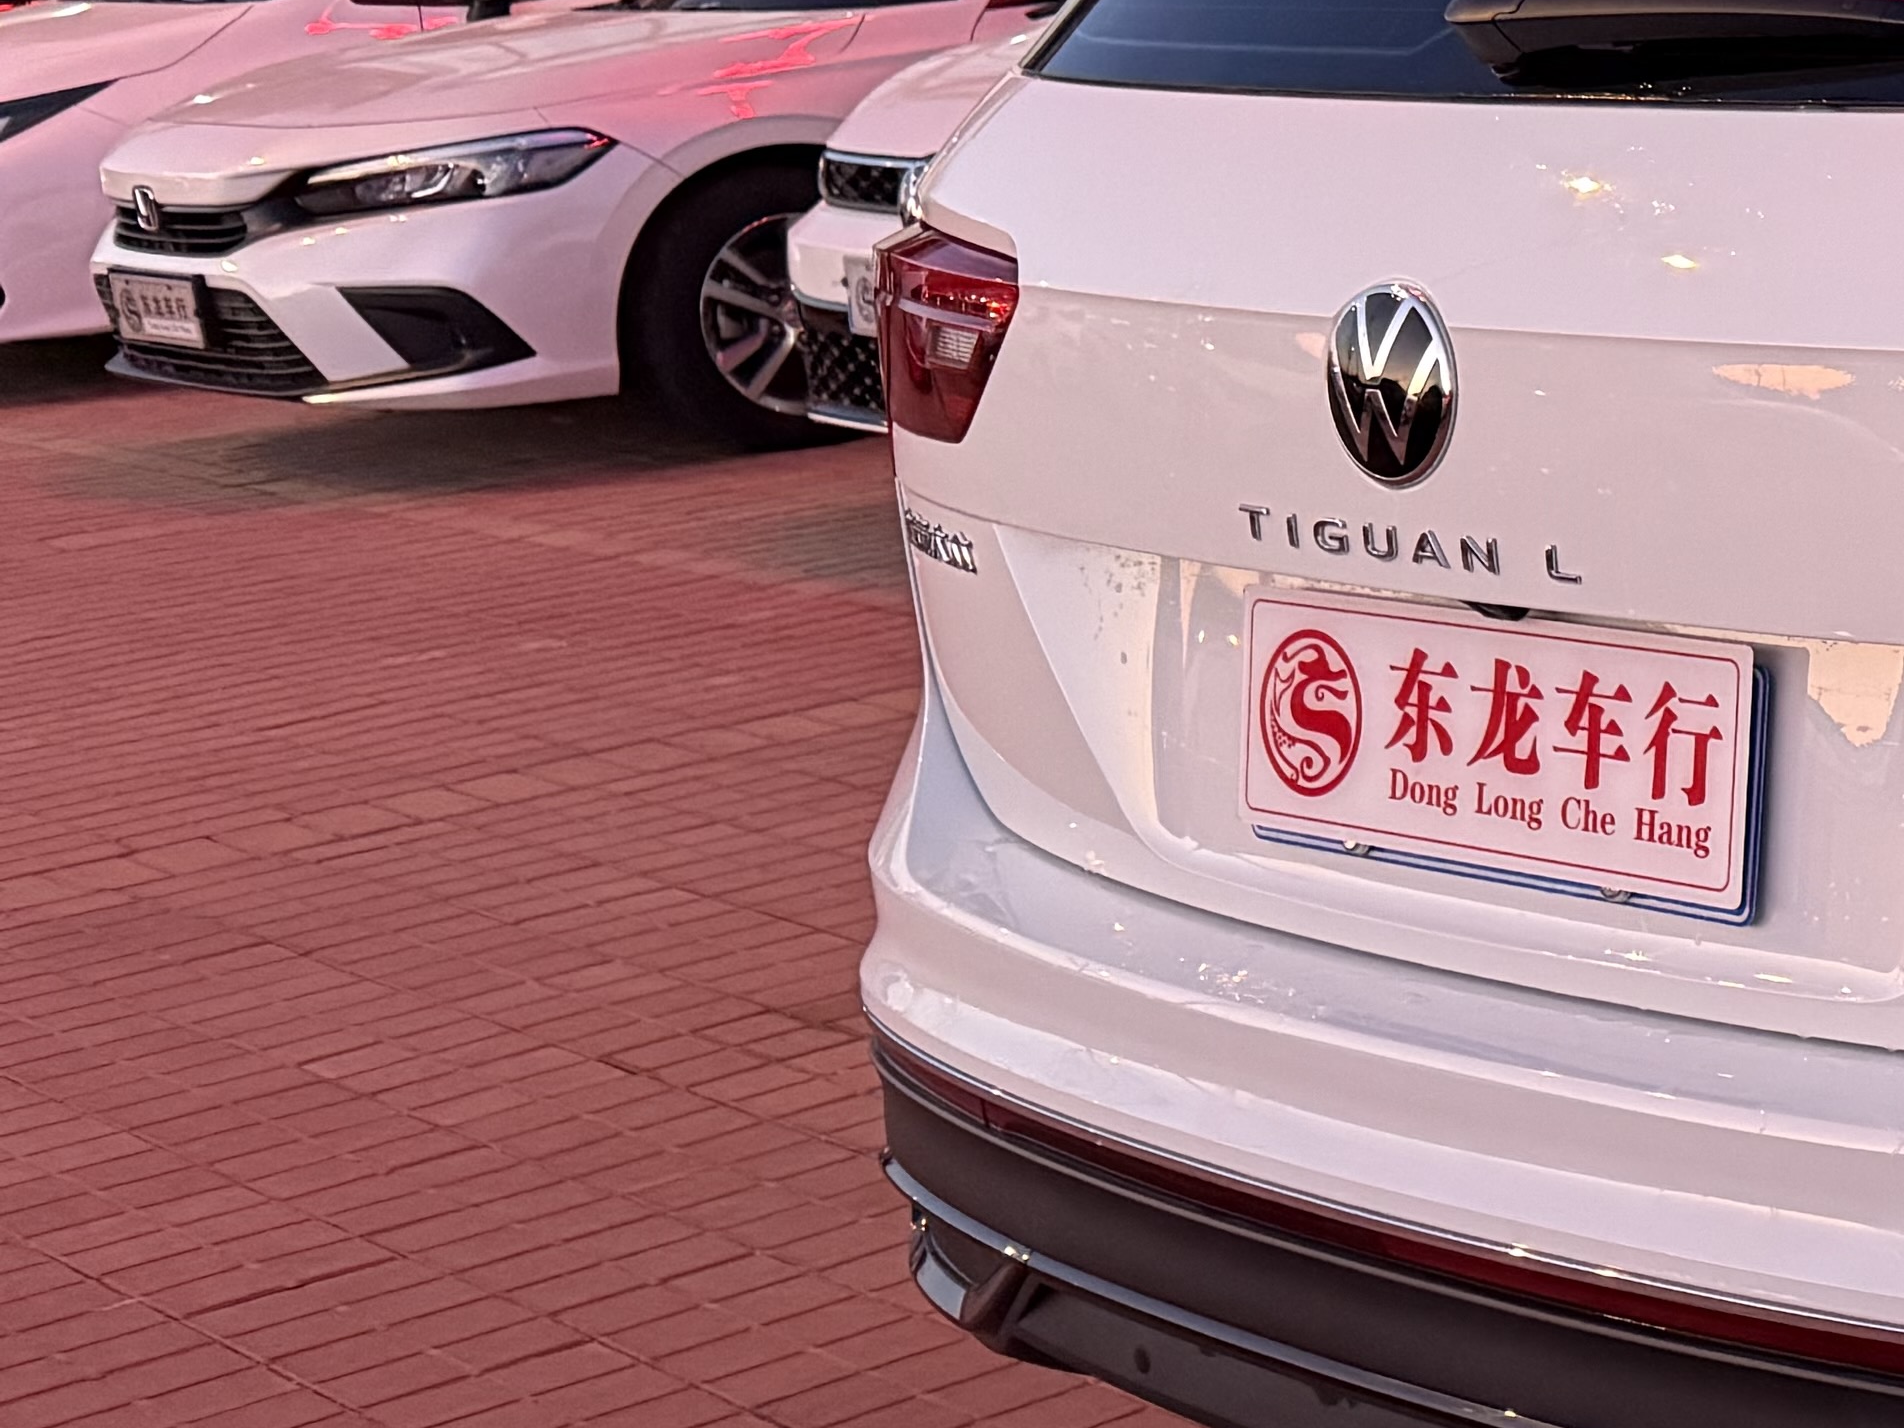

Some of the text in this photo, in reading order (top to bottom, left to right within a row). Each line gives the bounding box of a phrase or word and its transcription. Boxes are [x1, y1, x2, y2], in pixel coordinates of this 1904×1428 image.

[1239, 503, 1582, 584] TIGUAN L
[1384, 647, 1723, 806] 东龙车行
[1387, 767, 1712, 859] Dong Long Che Hang
